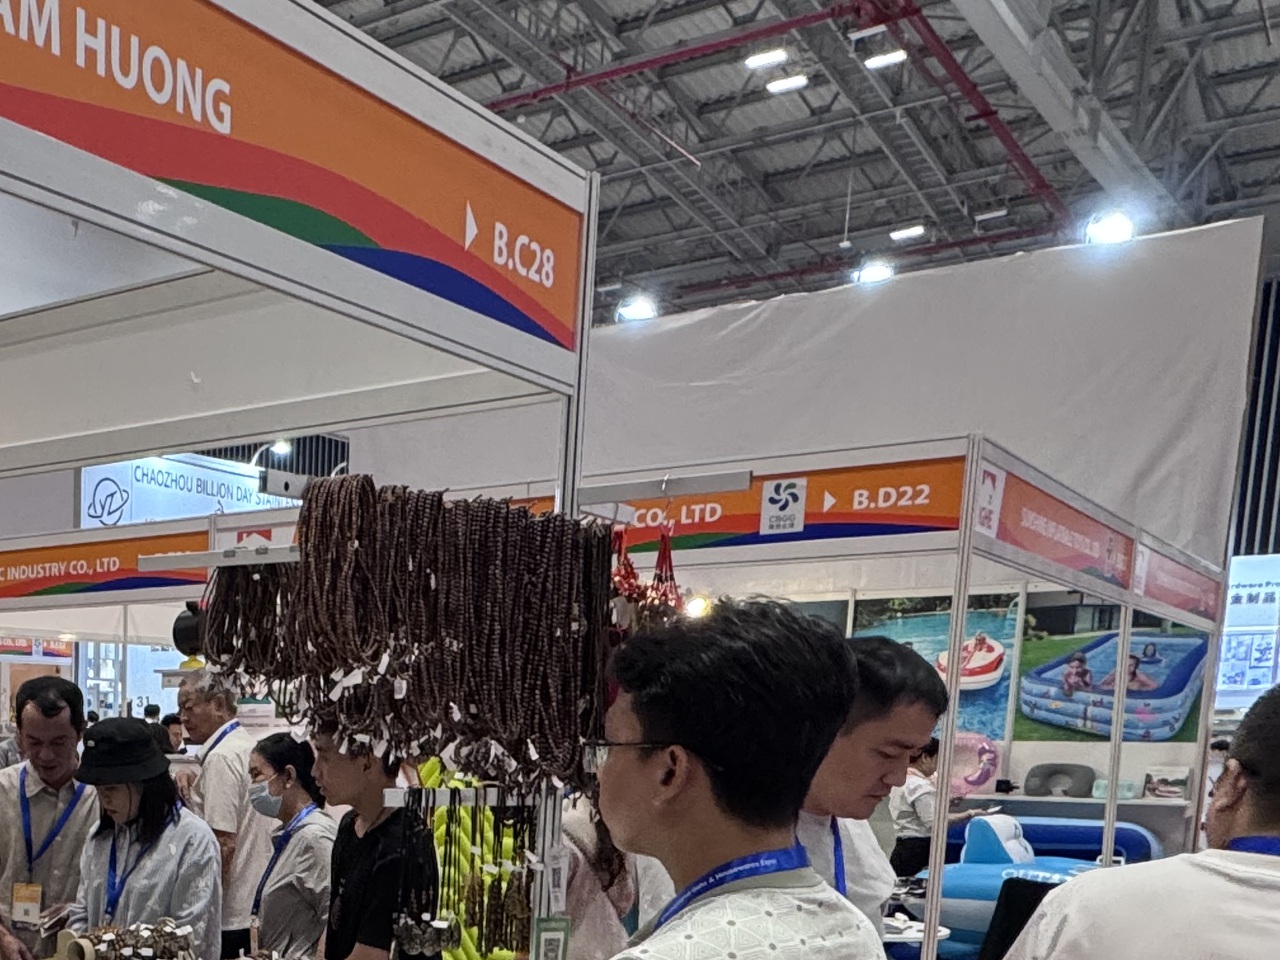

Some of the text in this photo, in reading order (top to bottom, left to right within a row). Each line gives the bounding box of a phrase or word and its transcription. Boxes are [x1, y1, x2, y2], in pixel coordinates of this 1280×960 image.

[76, 7, 231, 134] HUONG
[493, 221, 555, 289] B.C28
[134, 465, 193, 492] CHAOZHOU
[196, 477, 234, 500] BILLION
[236, 485, 252, 502] DAY
[853, 484, 930, 511] B.D22
[681, 503, 722, 524] LTD
[7, 562, 66, 580] INDUSTRY
[69, 558, 93, 576] CO.,
[96, 557, 120, 573] LTD
